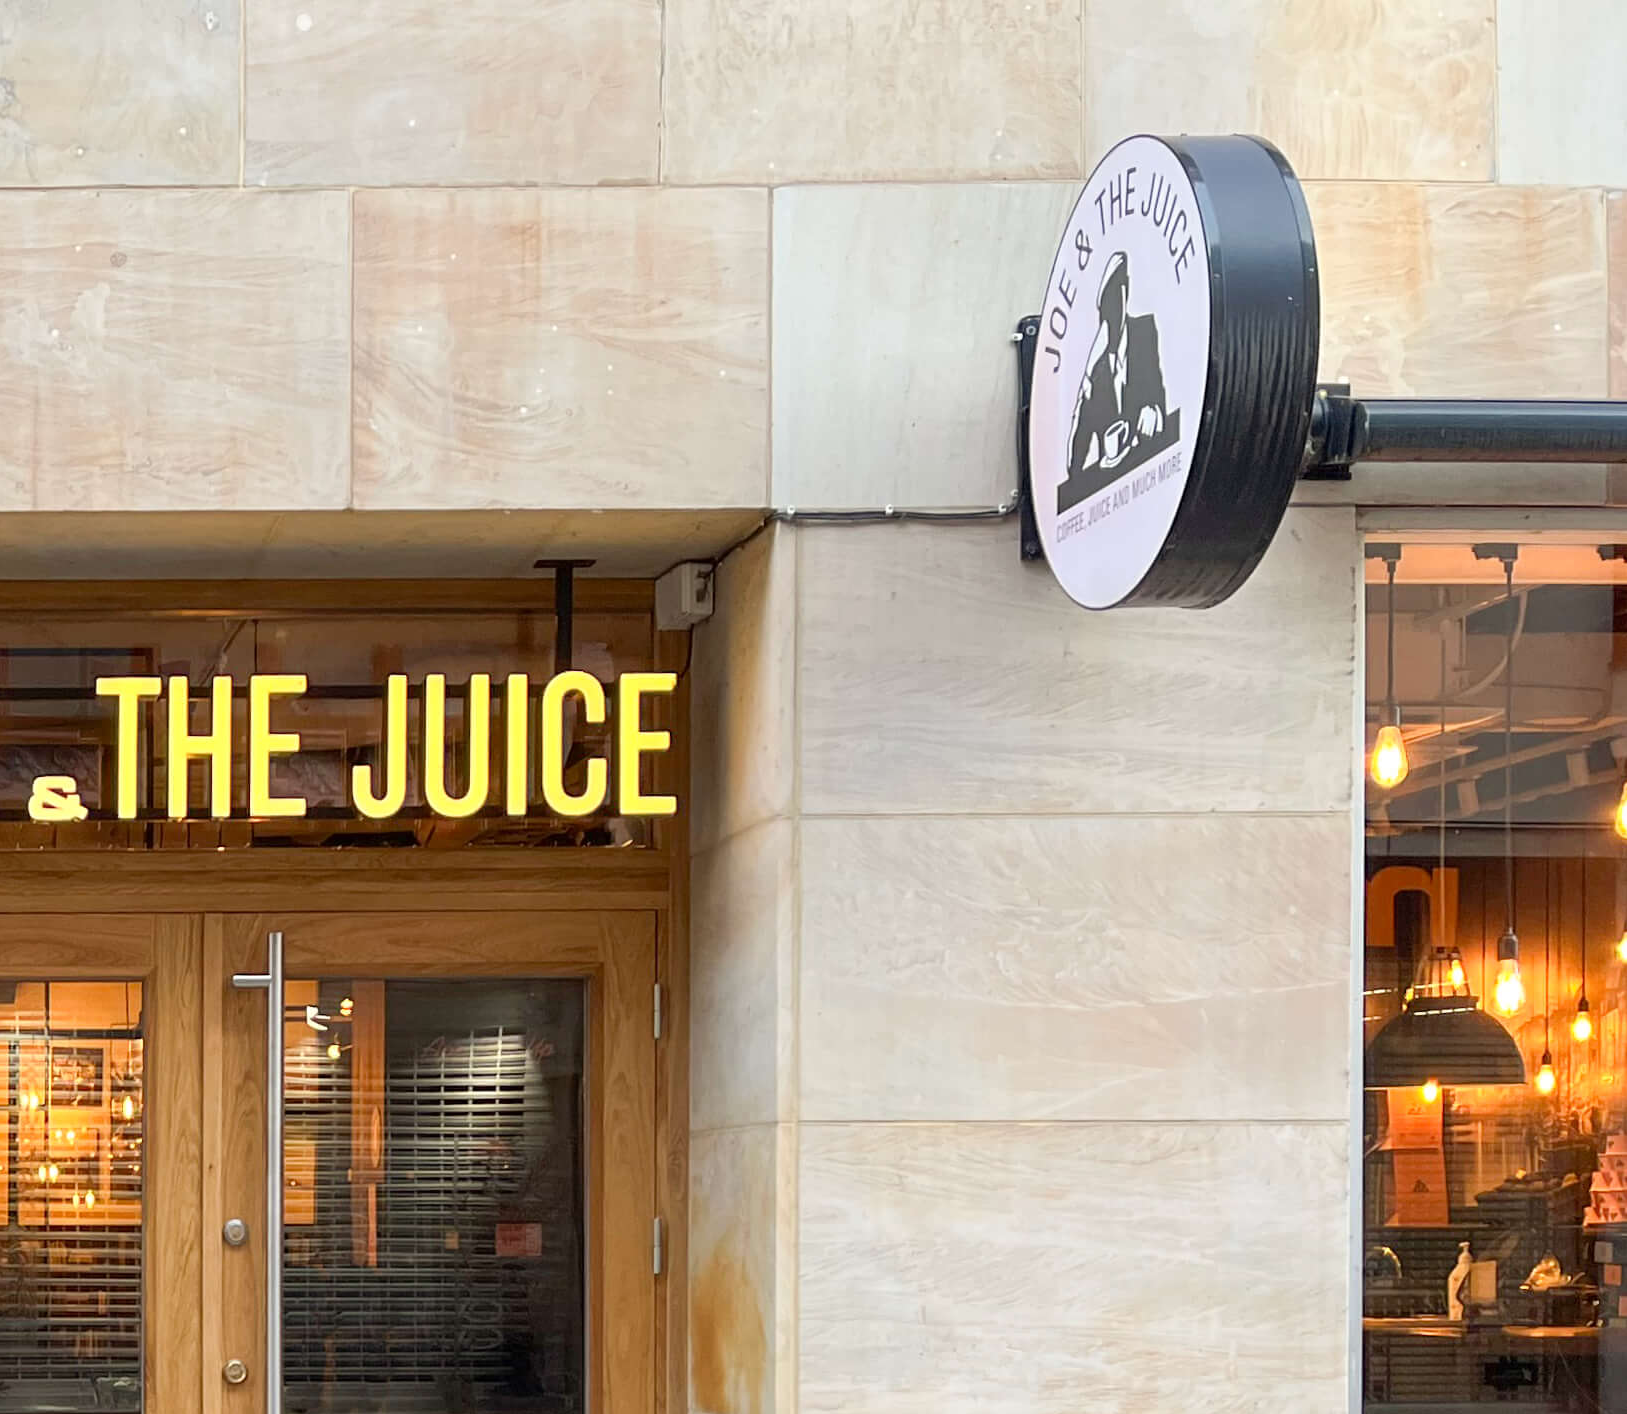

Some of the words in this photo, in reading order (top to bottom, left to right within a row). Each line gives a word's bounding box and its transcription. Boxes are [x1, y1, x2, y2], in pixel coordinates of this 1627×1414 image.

[1045, 269, 1077, 373] JOE
[1075, 229, 1093, 271] &
[1095, 167, 1137, 235] THE
[1141, 172, 1195, 285] JUICE
[1087, 496, 1111, 526] JUICE
[1112, 484, 1130, 512] AND
[1132, 470, 1156, 500] MUCH
[27, 775, 89, 822] &
[95, 673, 309, 819] THE
[351, 670, 678, 818] JUICE
